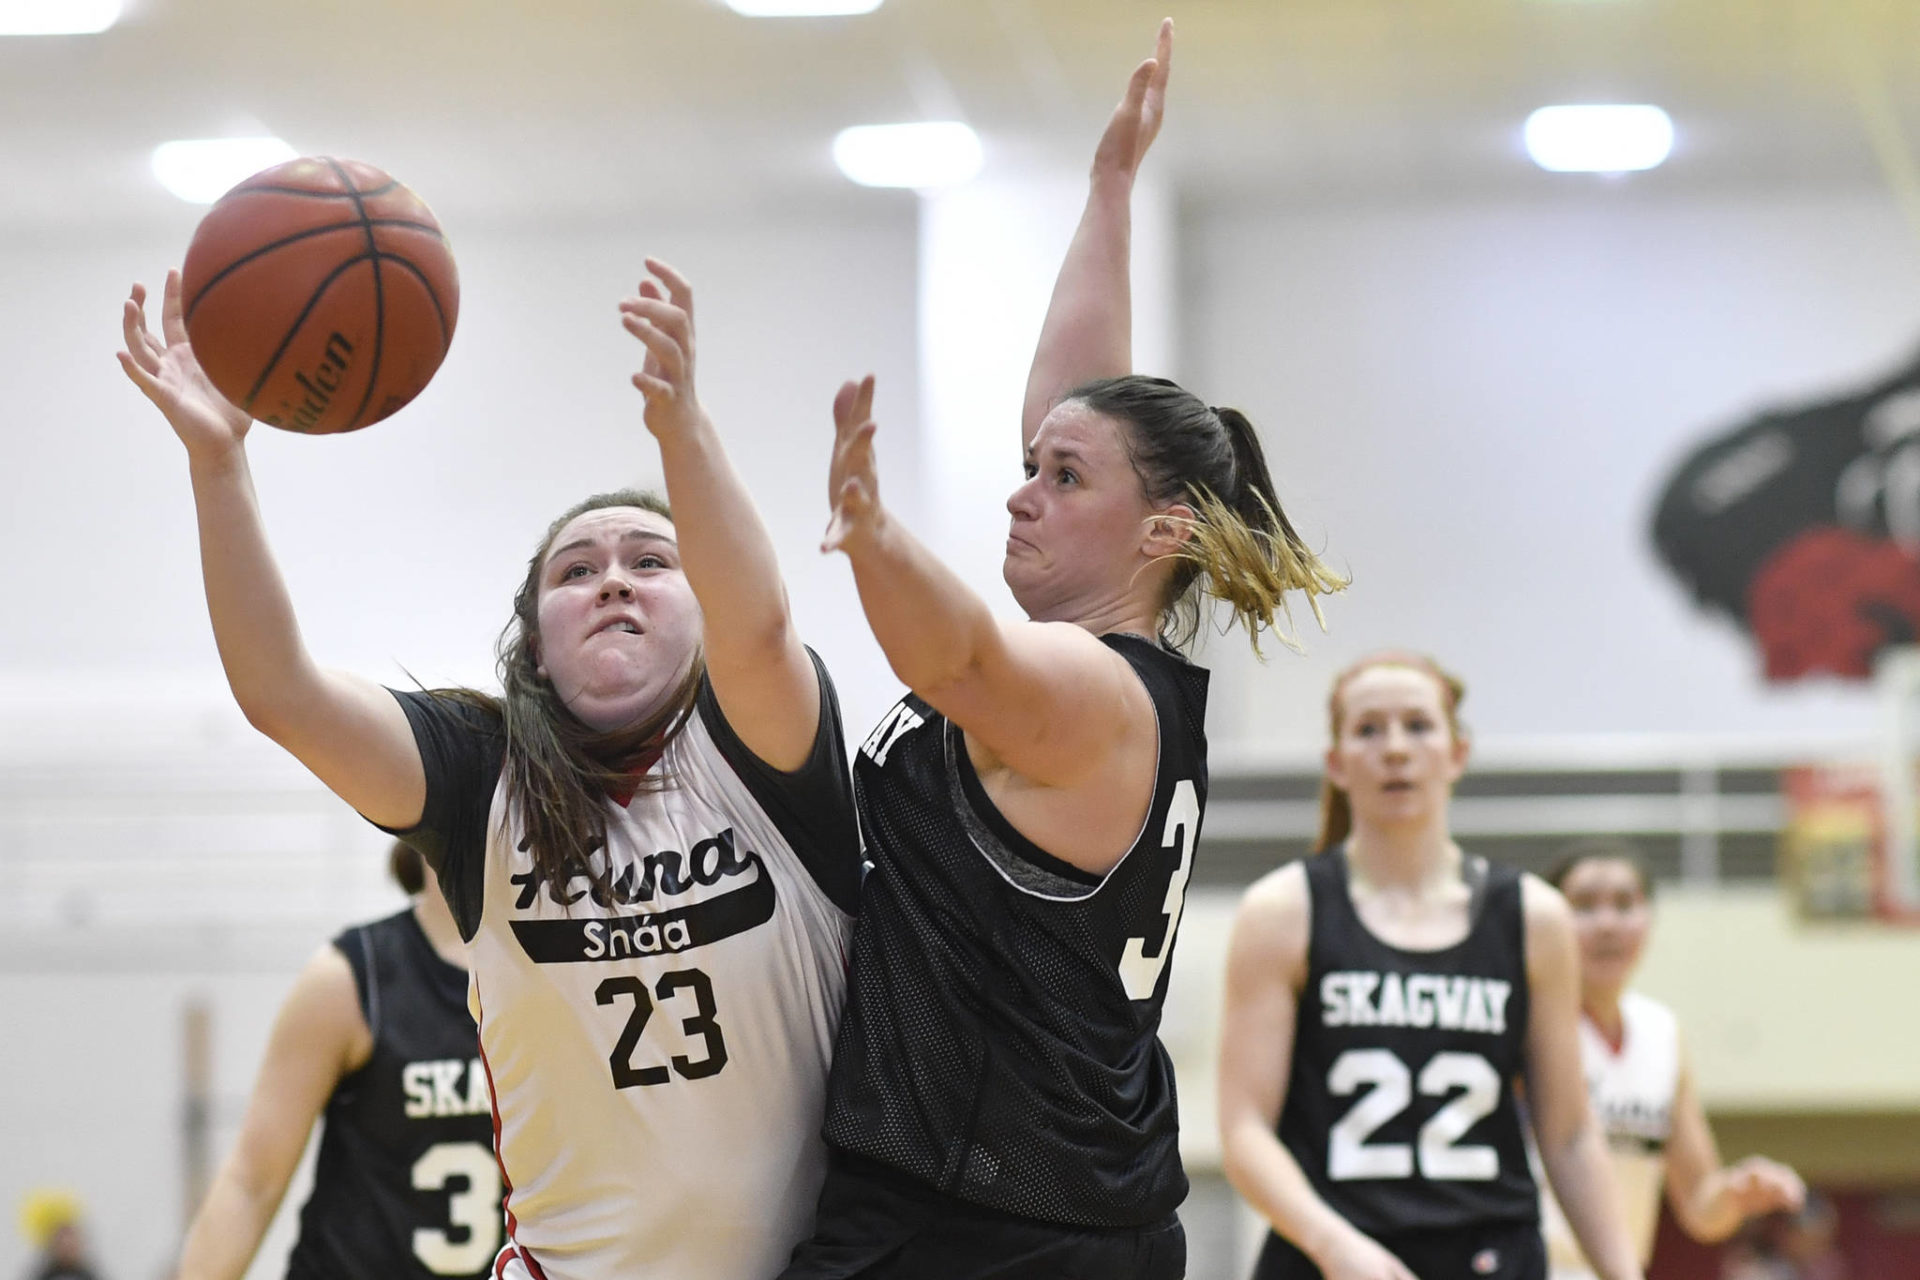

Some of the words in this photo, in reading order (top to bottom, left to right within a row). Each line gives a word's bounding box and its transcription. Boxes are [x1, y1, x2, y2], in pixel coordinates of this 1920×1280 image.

[1118, 779, 1200, 1000] 3
[595, 968, 728, 1090] 23
[1320, 971, 1511, 1035] SKAGWAY
[1327, 1048, 1500, 1181] 22
[411, 1141, 500, 1275] 3
